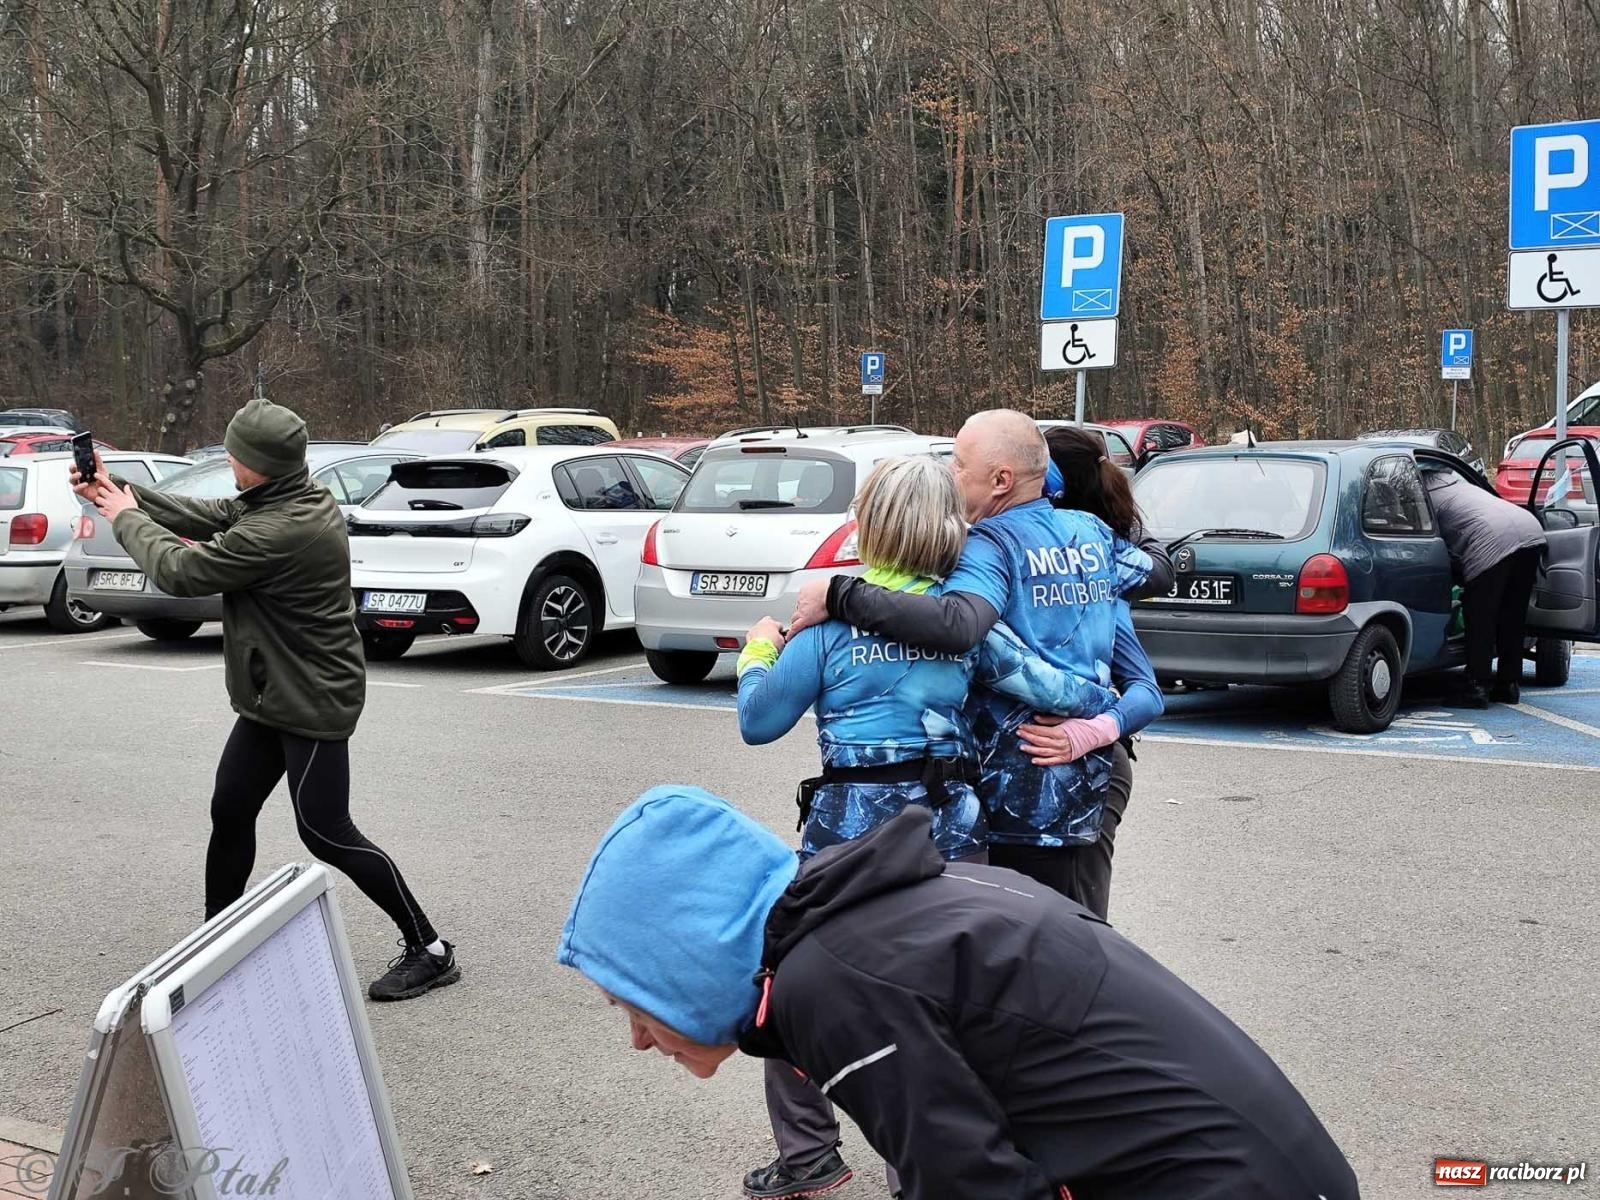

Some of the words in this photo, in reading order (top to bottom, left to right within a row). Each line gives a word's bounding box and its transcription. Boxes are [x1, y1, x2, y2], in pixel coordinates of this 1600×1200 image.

[1534, 134, 1589, 212] P
[1060, 224, 1105, 289] P
[1449, 332, 1467, 356] P
[867, 355, 880, 375] P
[1025, 541, 1109, 578] MORSY
[700, 574, 719, 590] SR
[722, 575, 765, 592] 3198G
[1189, 579, 1232, 599] 651F
[370, 593, 386, 607] SR
[387, 594, 424, 609] 0477U
